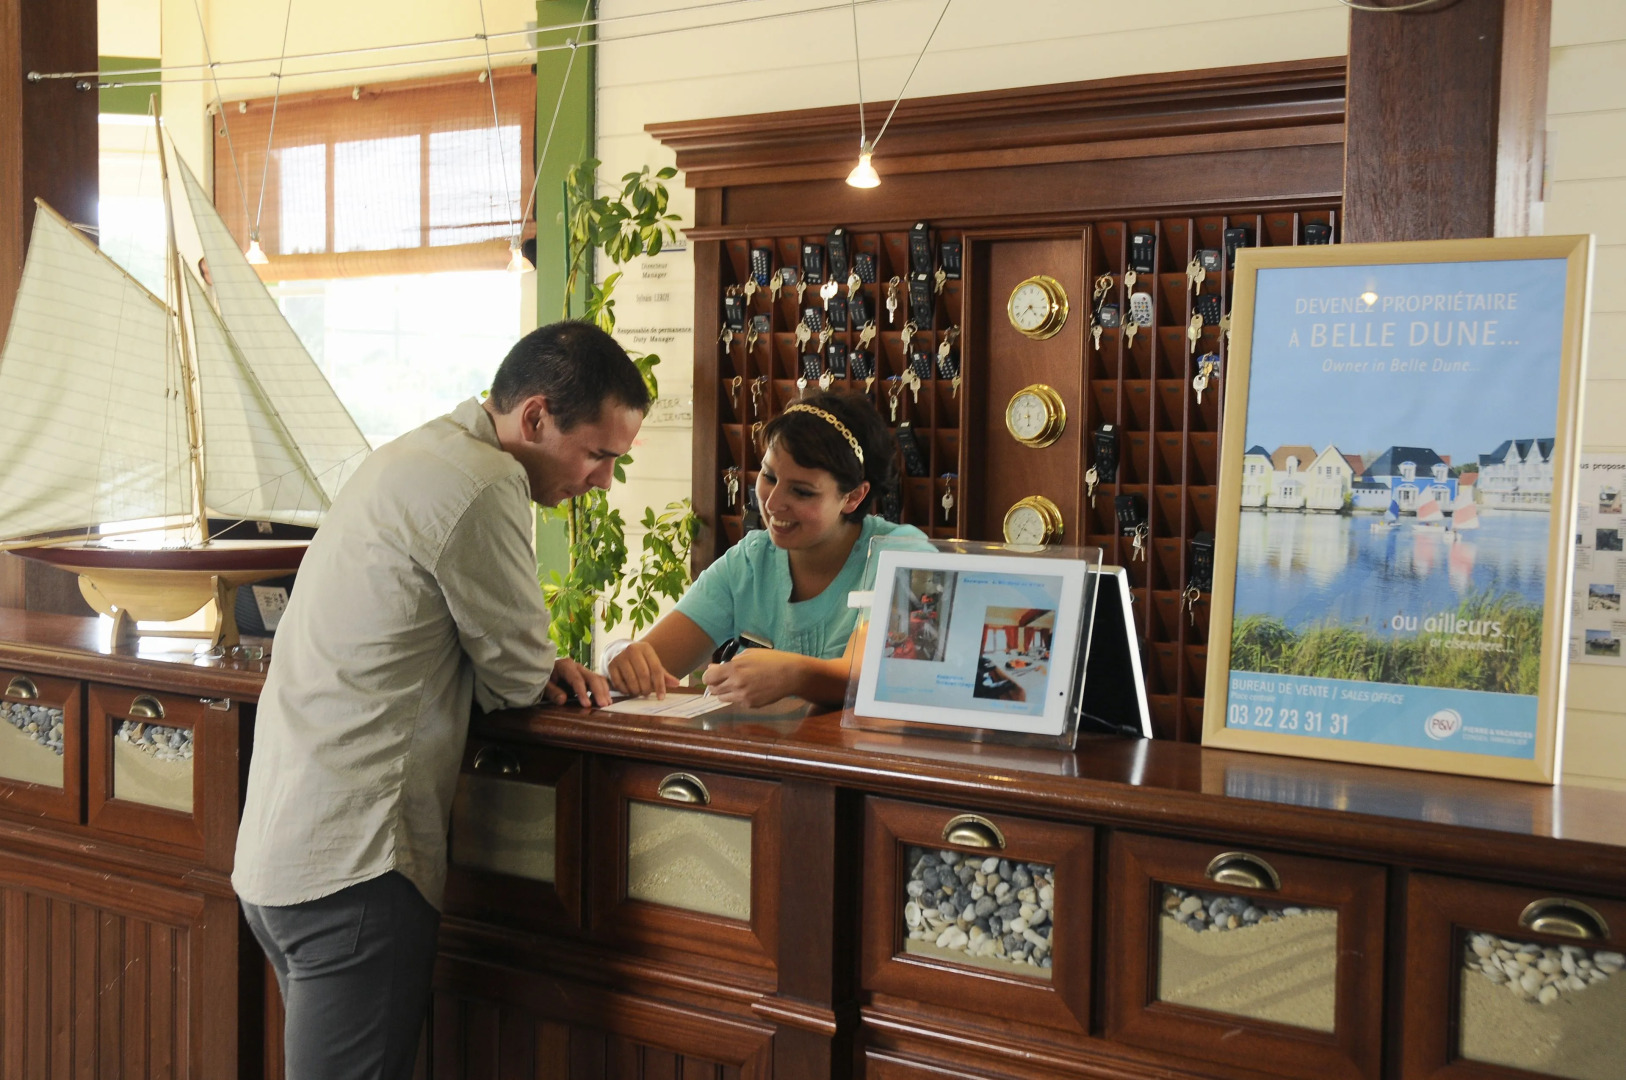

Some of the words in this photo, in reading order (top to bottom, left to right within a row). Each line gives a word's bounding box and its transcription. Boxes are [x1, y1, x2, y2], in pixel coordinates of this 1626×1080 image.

[642, 271, 667, 279] Manager
[1295, 297, 1375, 314] DEVENEZ
[1382, 290, 1518, 313] PROPRIÉTAIRE
[617, 327, 649, 335] Responsable
[1310, 322, 1397, 348] BELLE
[1409, 320, 1520, 347] DUNE...
[1322, 358, 1368, 373] Owner
[1372, 359, 1385, 372] in
[1390, 358, 1427, 373] Belle
[1391, 615, 1418, 631] ou
[1423, 613, 1515, 638] ailleurs...
[1430, 639, 1442, 647] or
[1232, 679, 1275, 692] BUREAU
[1278, 682, 1293, 695] DE
[1295, 683, 1329, 698] VENTE
[1340, 689, 1369, 701] SALES
[1371, 691, 1405, 704] OFFICE
[1229, 704, 1249, 725] 03
[1254, 706, 1273, 727] 22
[1279, 708, 1298, 730] 23
[1304, 711, 1322, 732] 31
[1330, 713, 1348, 735] 31
[1431, 718, 1454, 731] P&V
